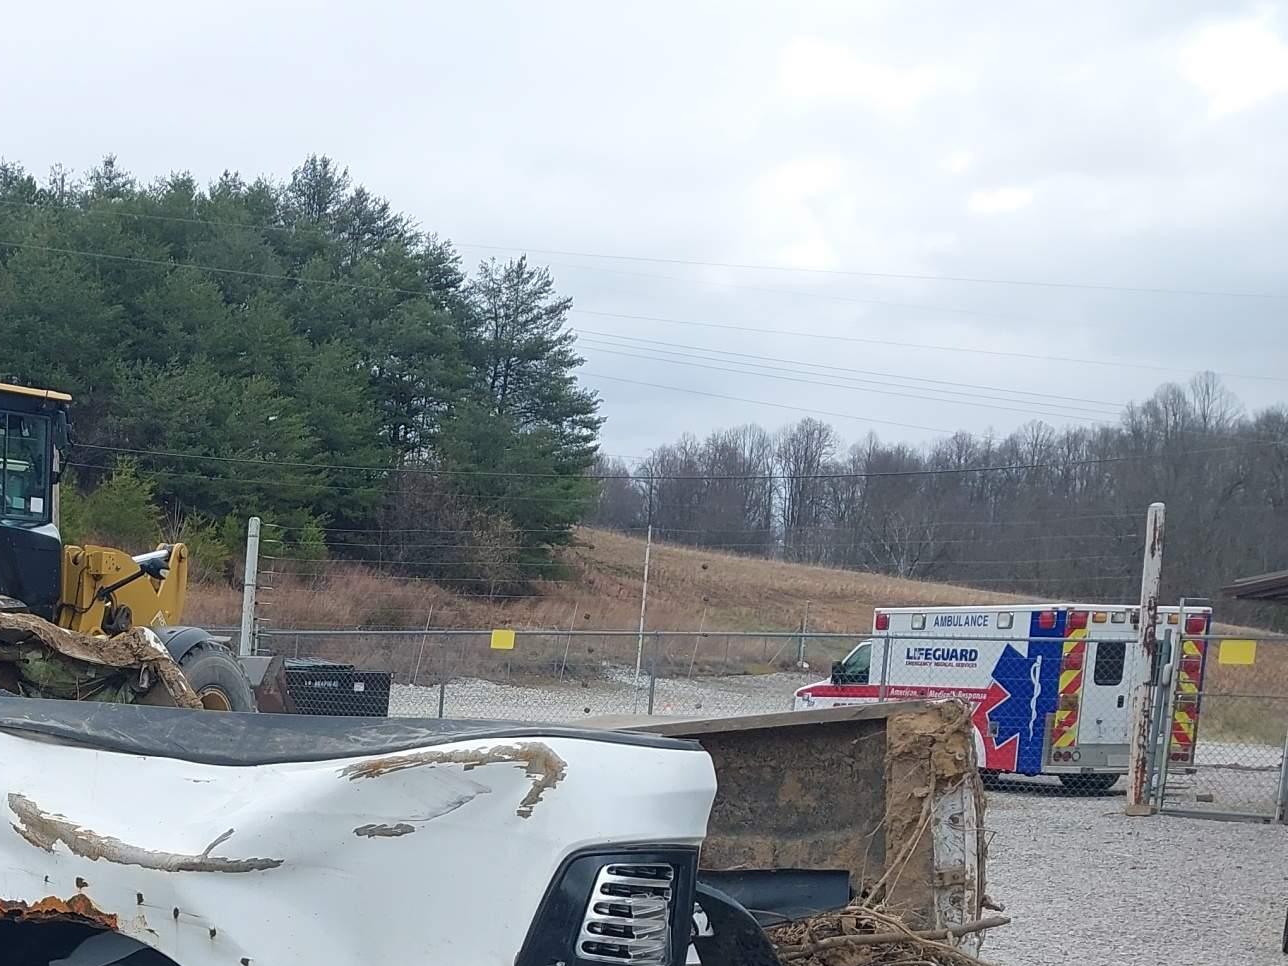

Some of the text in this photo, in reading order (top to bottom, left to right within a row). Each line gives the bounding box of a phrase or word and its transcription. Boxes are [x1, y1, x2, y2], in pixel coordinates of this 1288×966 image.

[934, 615, 989, 627] AMBULANCE
[906, 648, 979, 661] LIFEGUARD
[889, 687, 919, 697] American
[957, 690, 988, 700] Response
